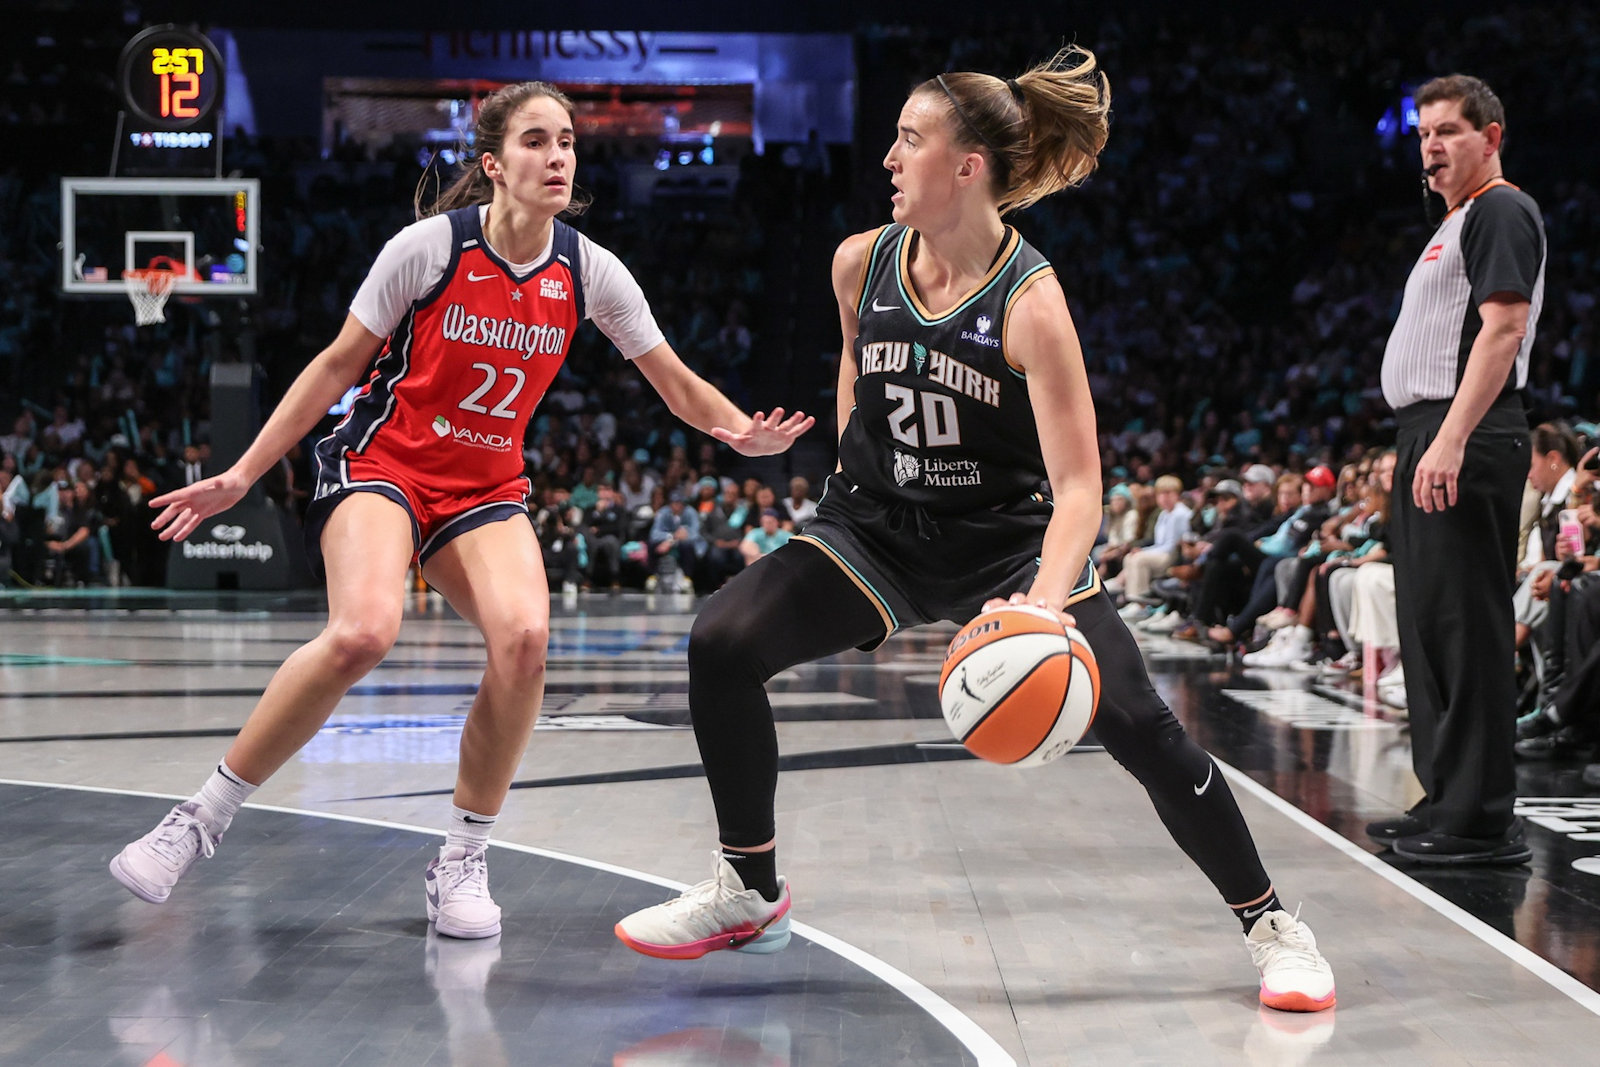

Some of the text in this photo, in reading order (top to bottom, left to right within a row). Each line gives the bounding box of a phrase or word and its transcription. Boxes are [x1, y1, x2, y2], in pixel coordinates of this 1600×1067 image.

[160, 72, 200, 118] 12
[540, 278, 563, 290] CAR
[540, 287, 568, 300] max
[442, 303, 566, 361] Washington
[961, 331, 999, 347] BARCLAYS
[861, 342, 1000, 409] NEW YORK
[458, 362, 526, 419] 22
[884, 382, 961, 449] 20
[452, 425, 513, 447] VANDA
[924, 458, 979, 475] Liberty
[924, 471, 982, 487] Mutual
[183, 540, 273, 563] betterhelp
